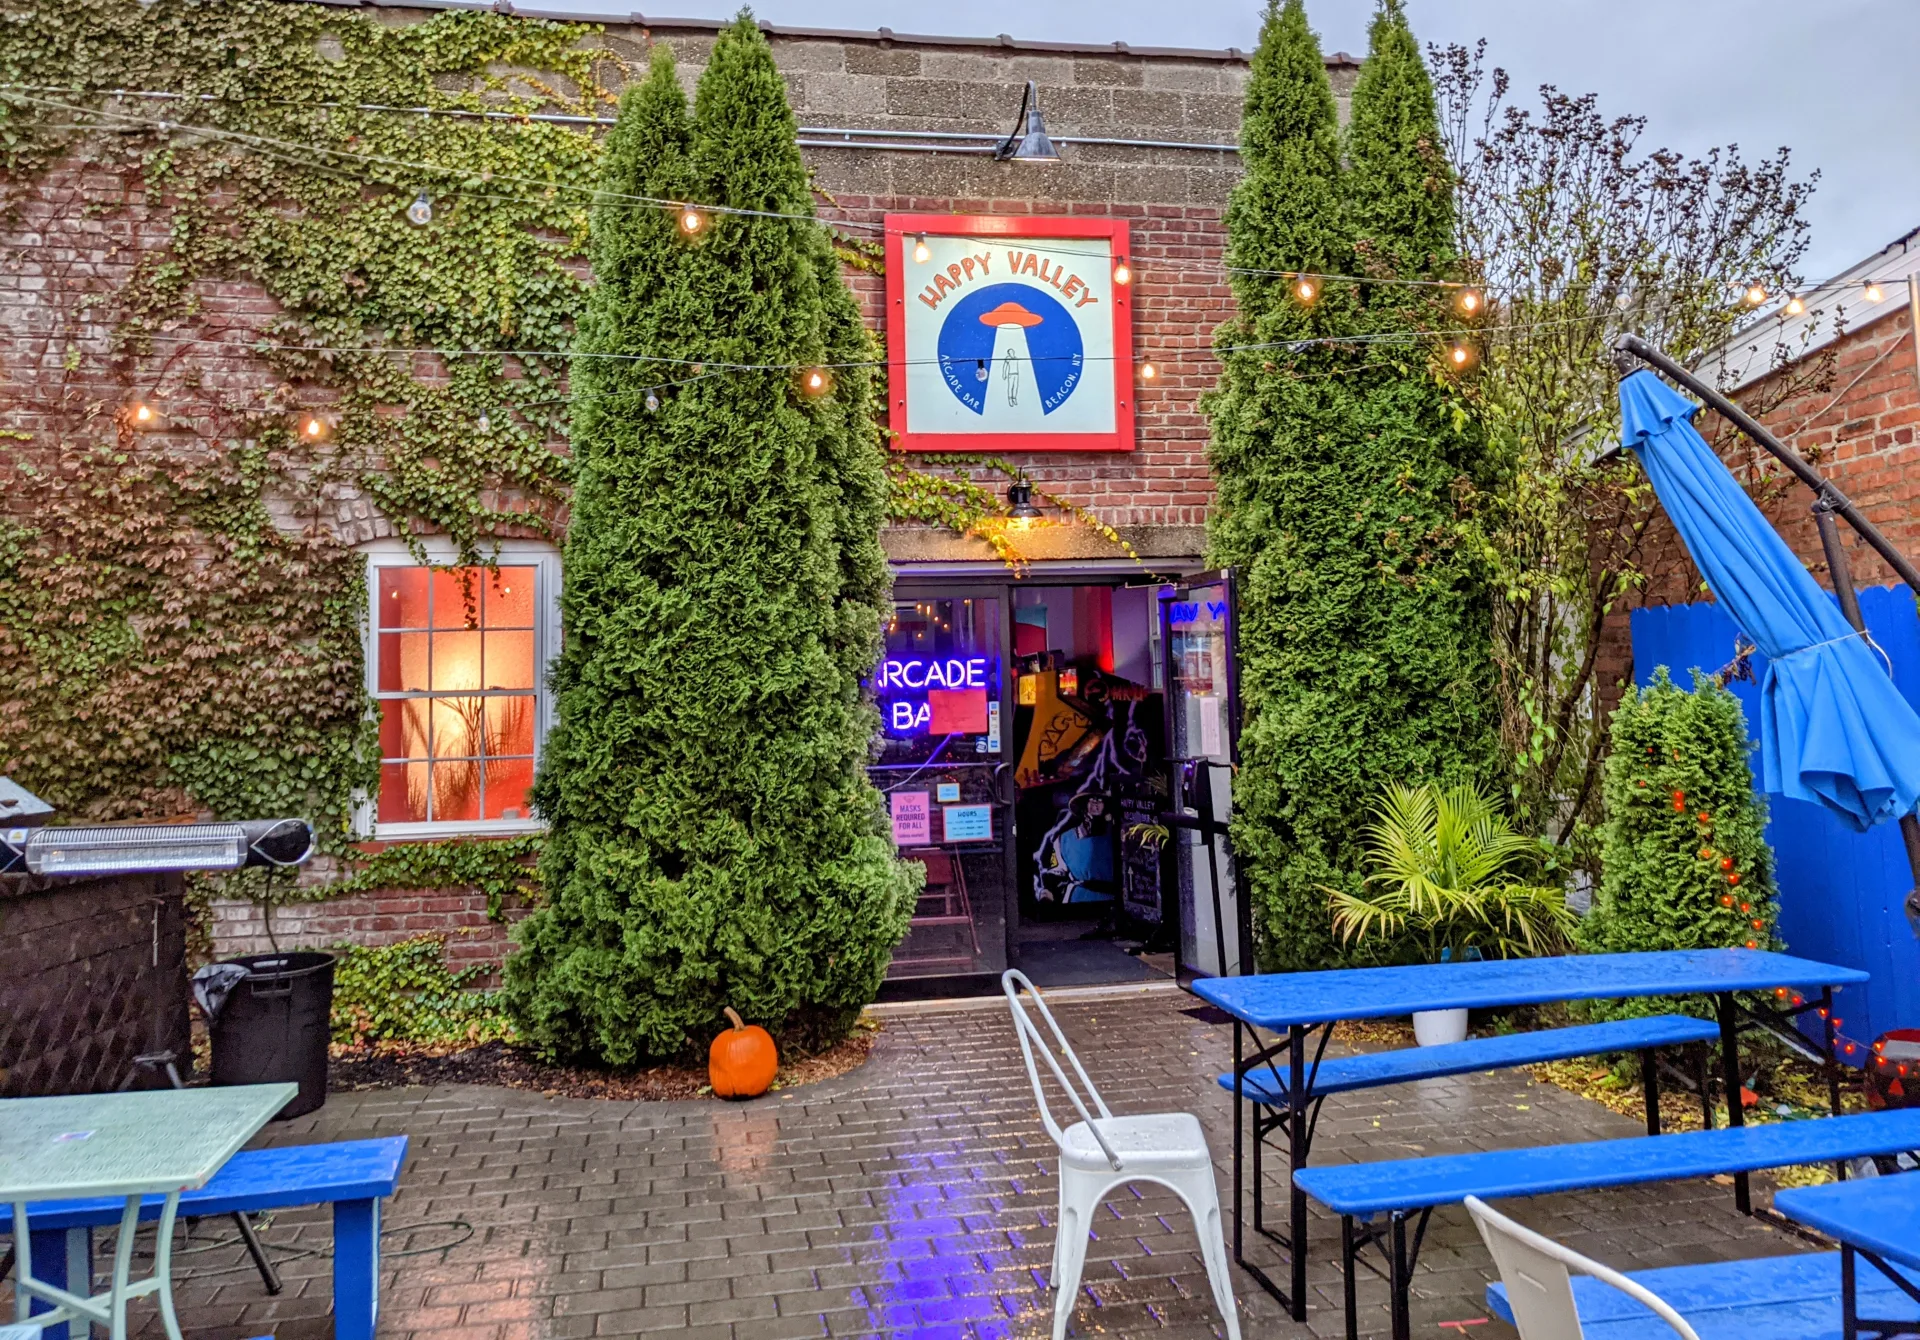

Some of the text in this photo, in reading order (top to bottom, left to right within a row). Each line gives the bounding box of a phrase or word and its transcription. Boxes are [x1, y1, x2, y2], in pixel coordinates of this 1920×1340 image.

[918, 250, 1099, 311] HAPPY VALLEY
[940, 354, 980, 409] ARCADE BAR
[1044, 352, 1082, 408] BEACON, NY
[877, 658, 986, 688] RCADE
[892, 701, 931, 730] BA
[895, 813, 926, 822] REQUIRED
[899, 804, 922, 813] MASKS
[957, 810, 978, 818] HOURS
[898, 821, 922, 830] FOR ALL
